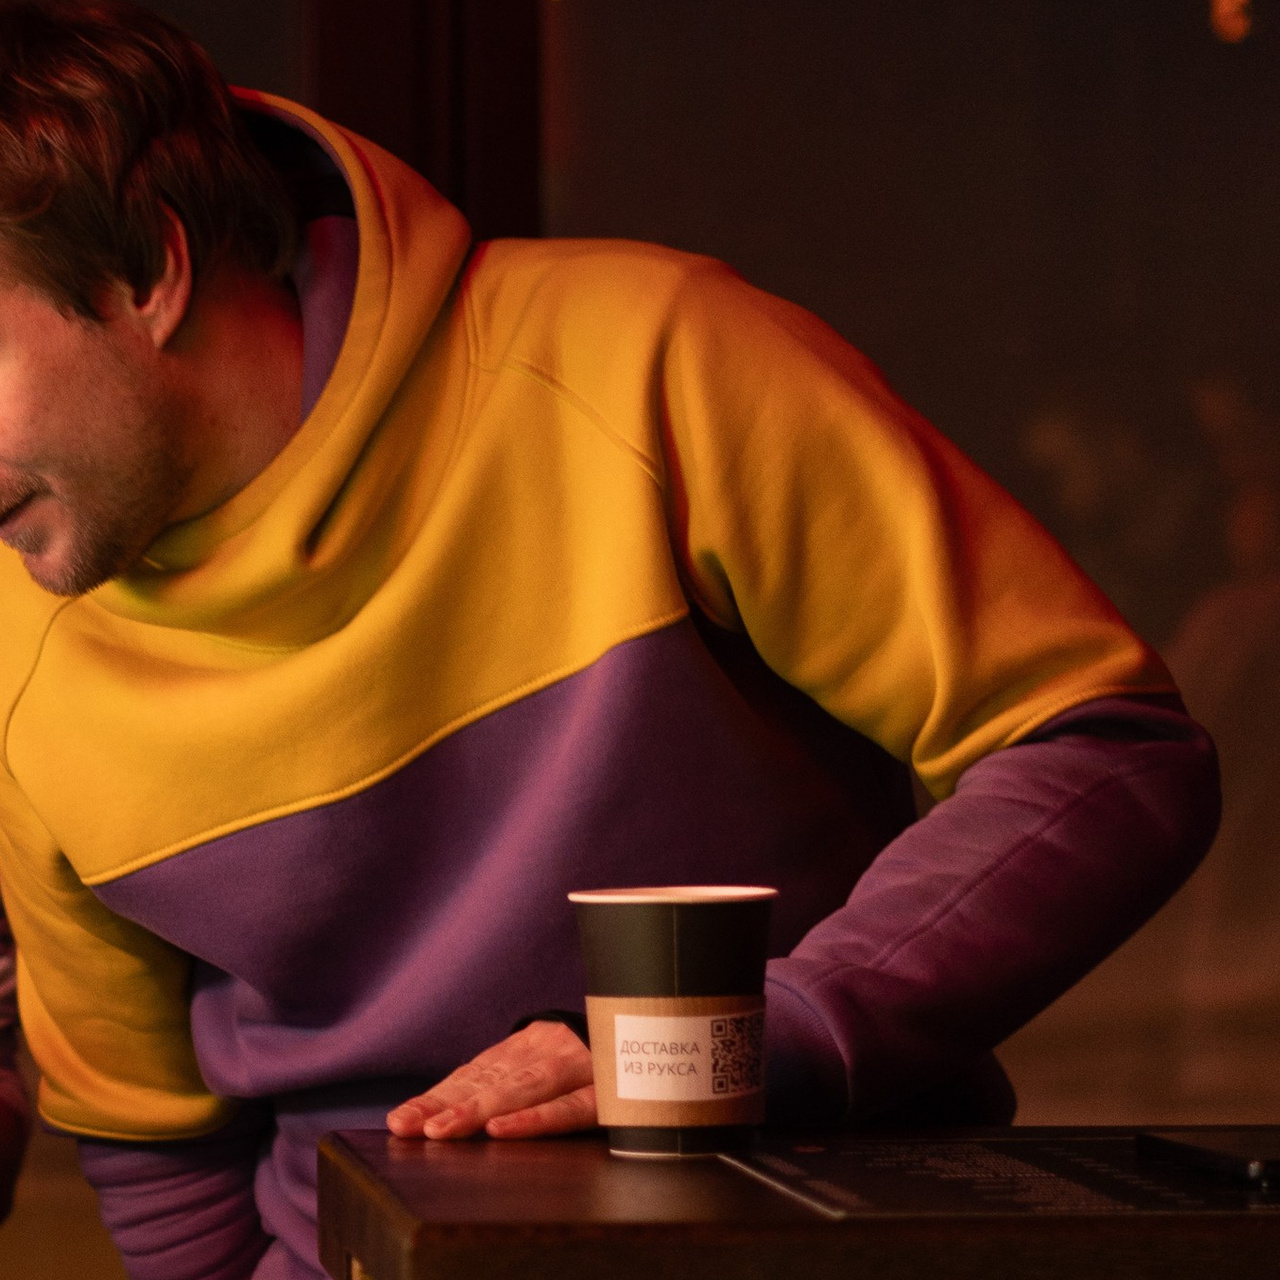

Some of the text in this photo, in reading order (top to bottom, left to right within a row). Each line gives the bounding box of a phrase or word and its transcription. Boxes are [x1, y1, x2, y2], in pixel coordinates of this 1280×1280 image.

[621, 1040, 700, 1055] ДОСТАВКА
[625, 1061, 697, 1076] ИЗ РУКСА
